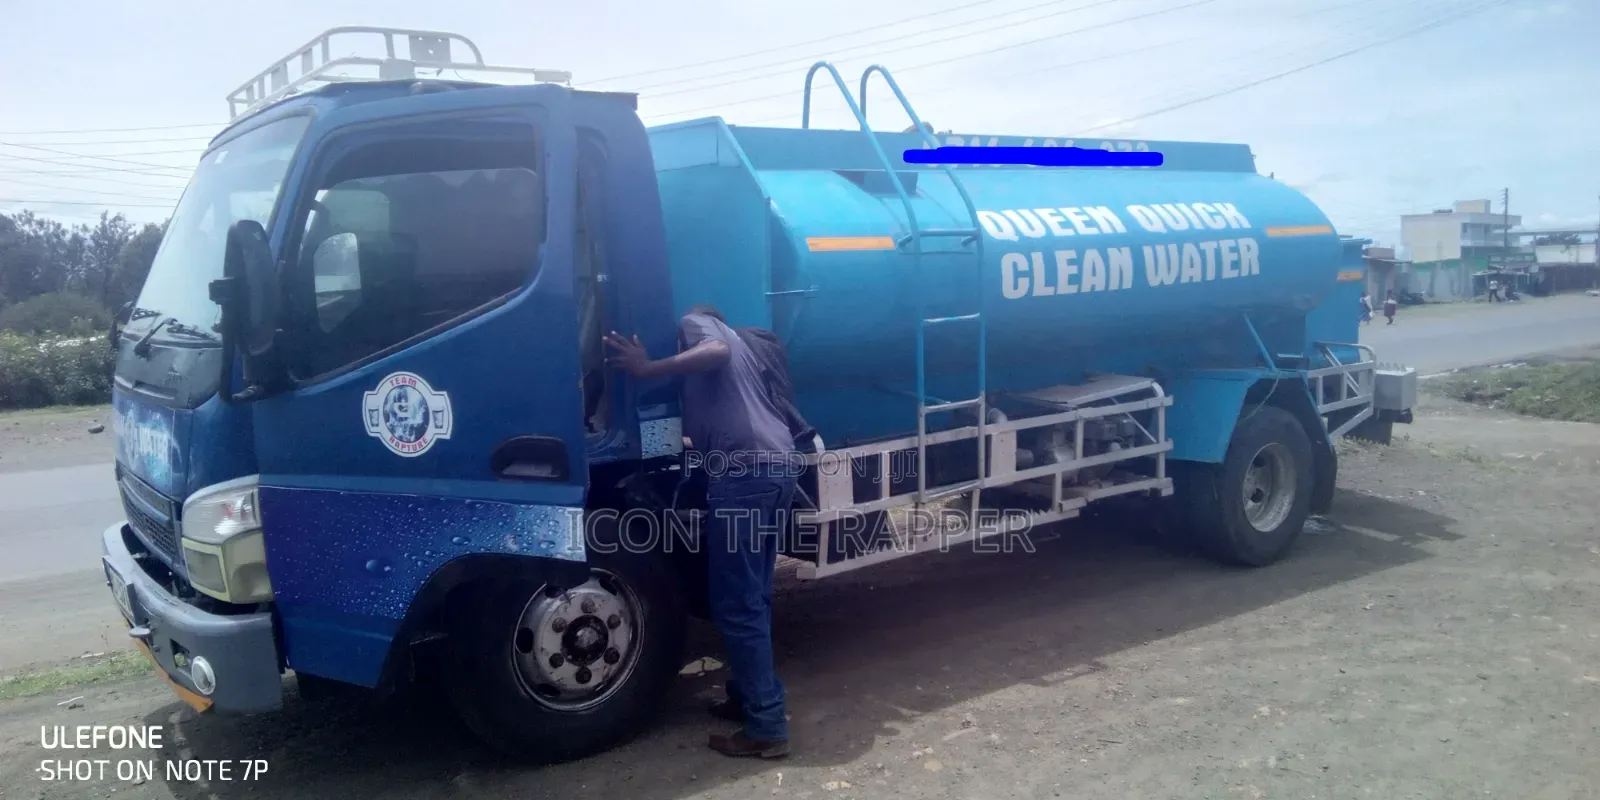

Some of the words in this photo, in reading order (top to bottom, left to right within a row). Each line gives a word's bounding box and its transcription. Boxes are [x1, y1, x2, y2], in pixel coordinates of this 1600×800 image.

[976, 205, 1127, 241] QUEEN
[1126, 202, 1252, 234] QUICK
[1001, 246, 1134, 299] CLEAN
[1143, 237, 1260, 287] WATER
[389, 376, 417, 387] TEAM
[388, 435, 428, 452] RAPTURE
